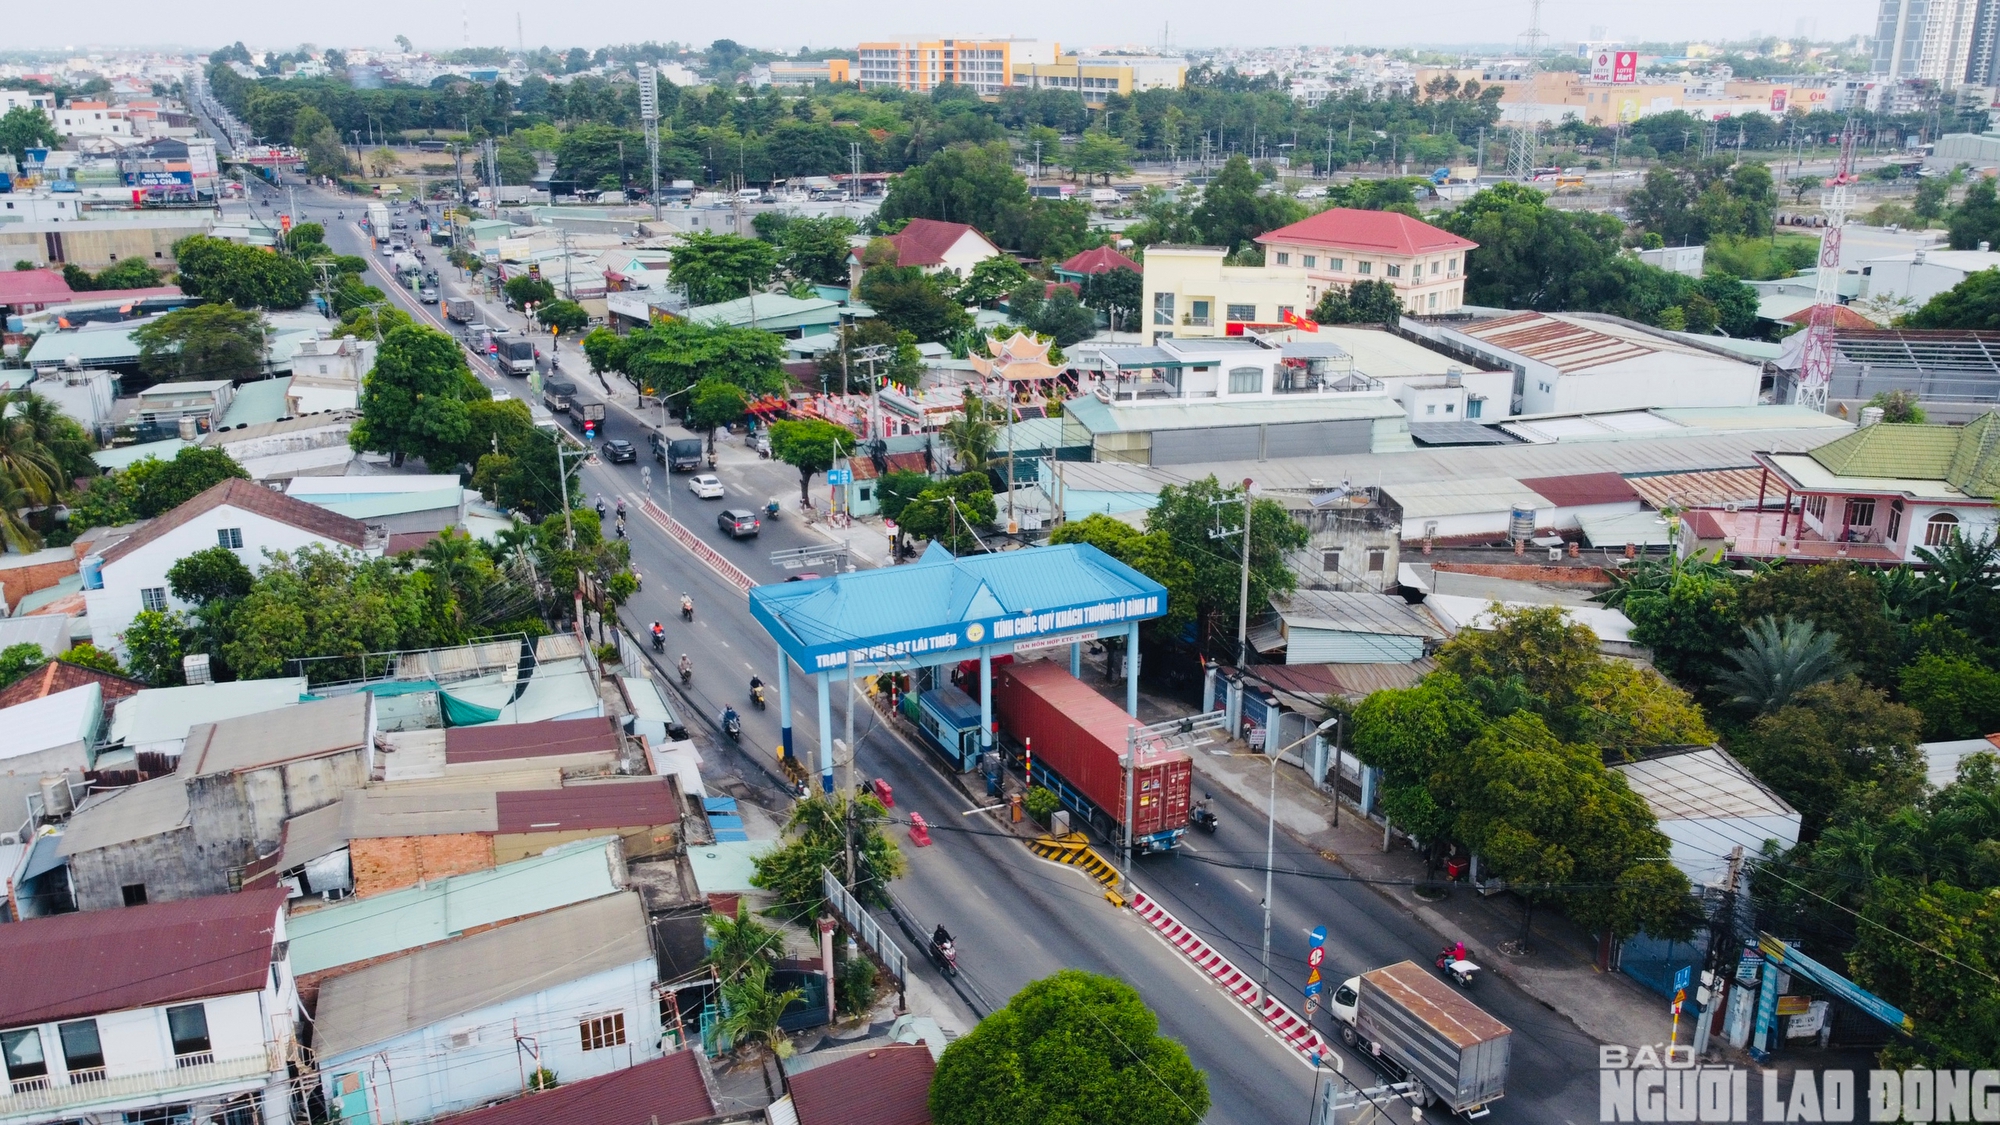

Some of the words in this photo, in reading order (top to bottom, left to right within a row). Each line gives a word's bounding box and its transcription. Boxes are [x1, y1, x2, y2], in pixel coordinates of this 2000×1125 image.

[994, 618, 1014, 638] KÍNH
[1015, 614, 1037, 635] CHÚC
[1038, 610, 1055, 633] QUÝ
[1055, 607, 1083, 628] KHÁCH
[1084, 602, 1115, 623] THƯỢNG
[1115, 598, 1126, 620] LỘ
[1126, 597, 1145, 617] BÌNH
[1146, 596, 1158, 614] AN
[815, 651, 846, 668] TRẠM
[912, 637, 928, 652] LÁI
[929, 632, 957, 649] THIÊU
